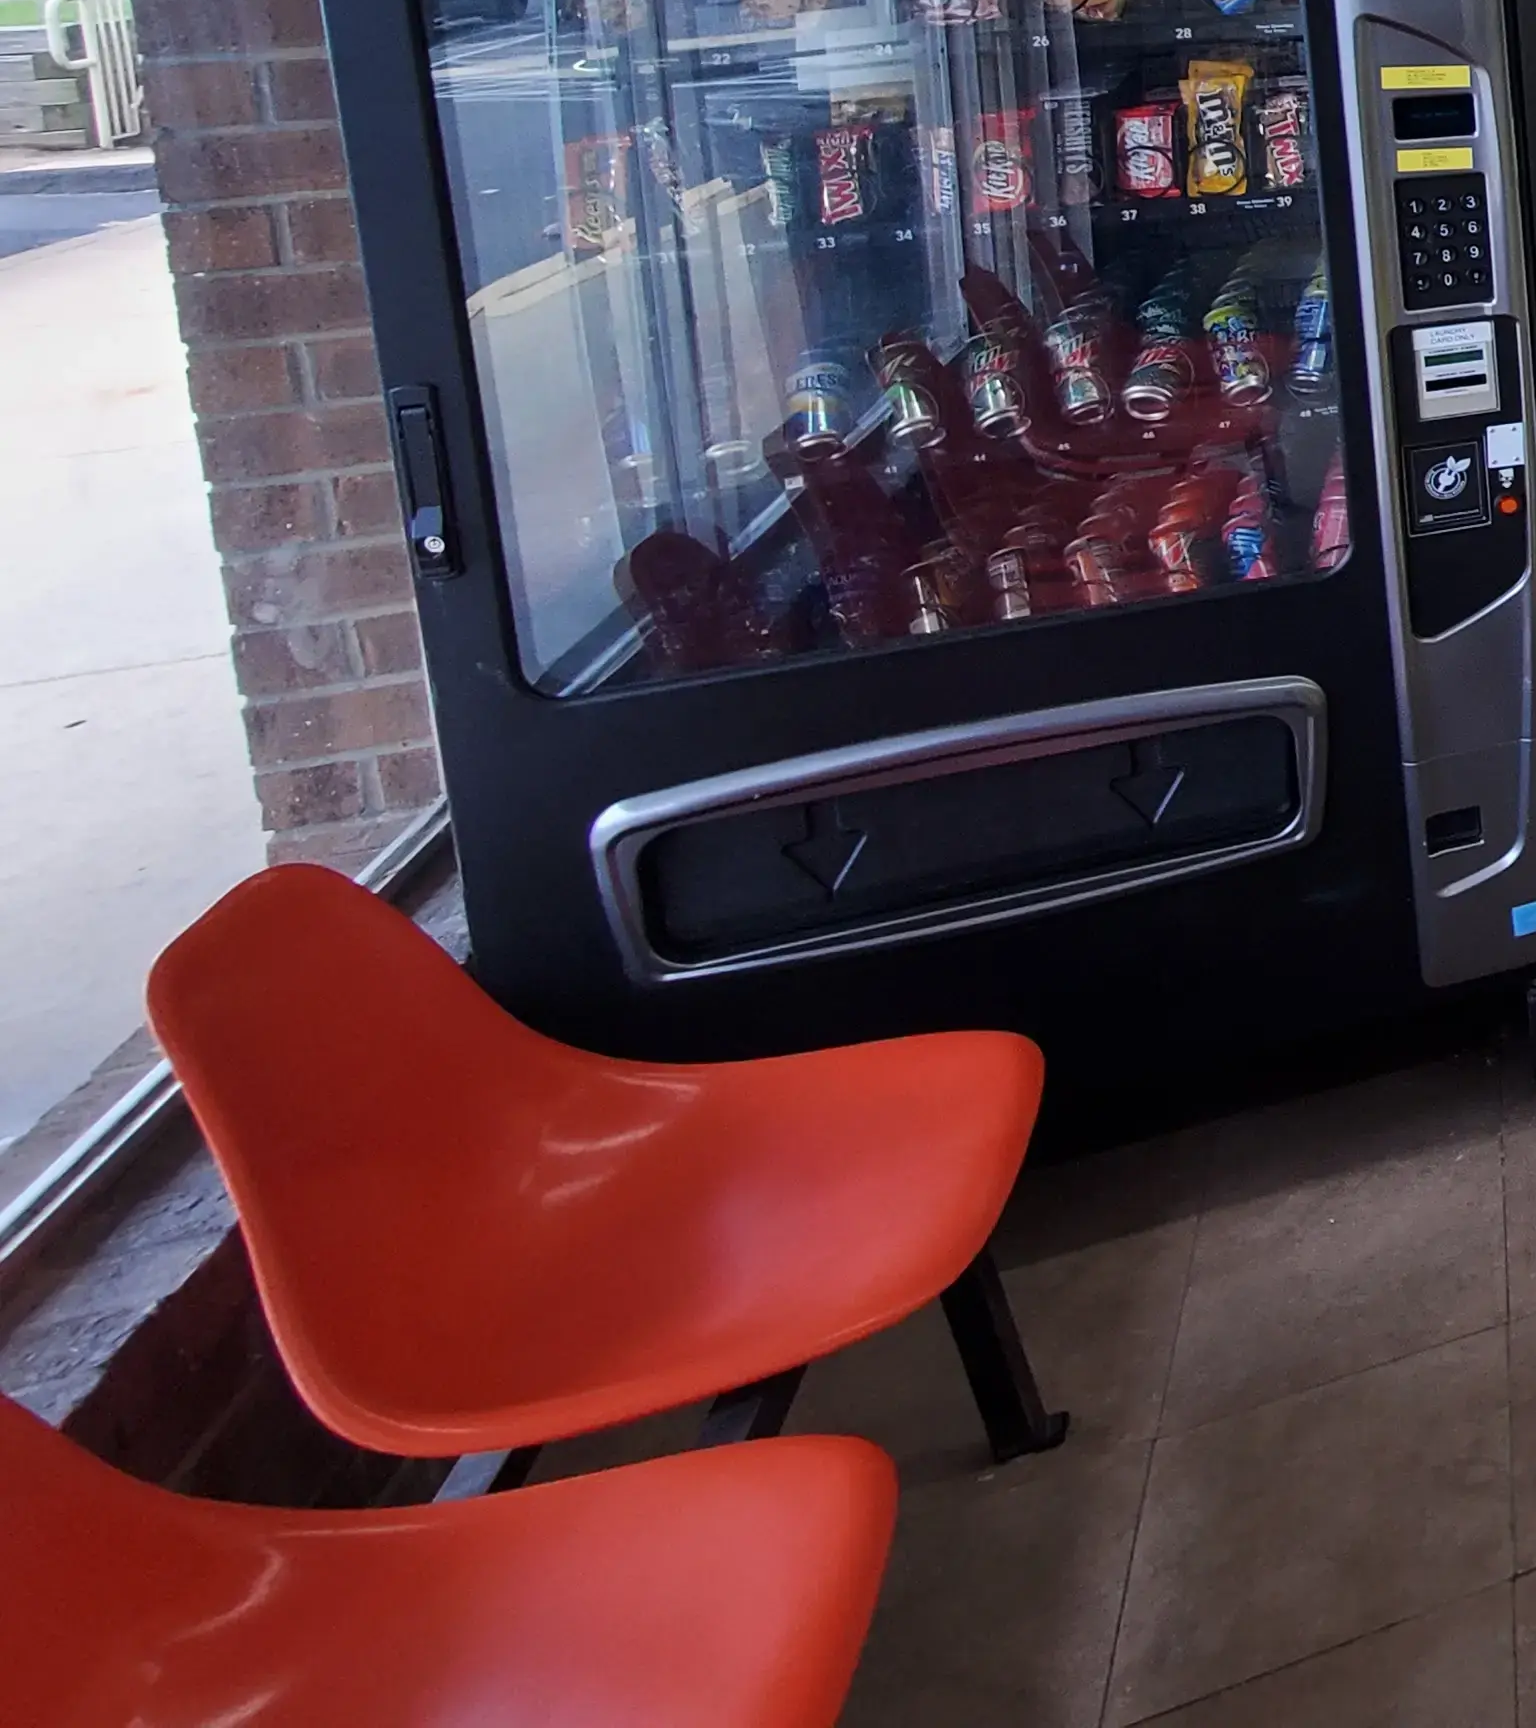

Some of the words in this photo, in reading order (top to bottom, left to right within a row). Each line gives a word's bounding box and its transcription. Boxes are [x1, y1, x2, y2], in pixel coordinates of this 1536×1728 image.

[1175, 28, 1193, 40] 28
[1032, 35, 1050, 48] 26
[875, 44, 893, 56] 24
[711, 53, 731, 65] 22
[1275, 195, 1293, 208] 39
[1409, 200, 1418, 214] 1
[1438, 198, 1447, 211] 2
[1465, 195, 1476, 208] 3
[1120, 208, 1138, 222] 37
[1189, 203, 1207, 215] 38
[1049, 215, 1067, 228] 36
[1468, 221, 1478, 234] 6
[894, 228, 914, 242] 34
[973, 222, 992, 235] 35
[1411, 225, 1420, 239] 4
[1440, 224, 1449, 237] 5
[816, 236, 836, 250] 33
[1442, 249, 1451, 262] 8
[1469, 245, 1480, 258] 9
[1413, 252, 1422, 265] 7
[1444, 273, 1453, 286] 0
[1218, 420, 1231, 429] 47
